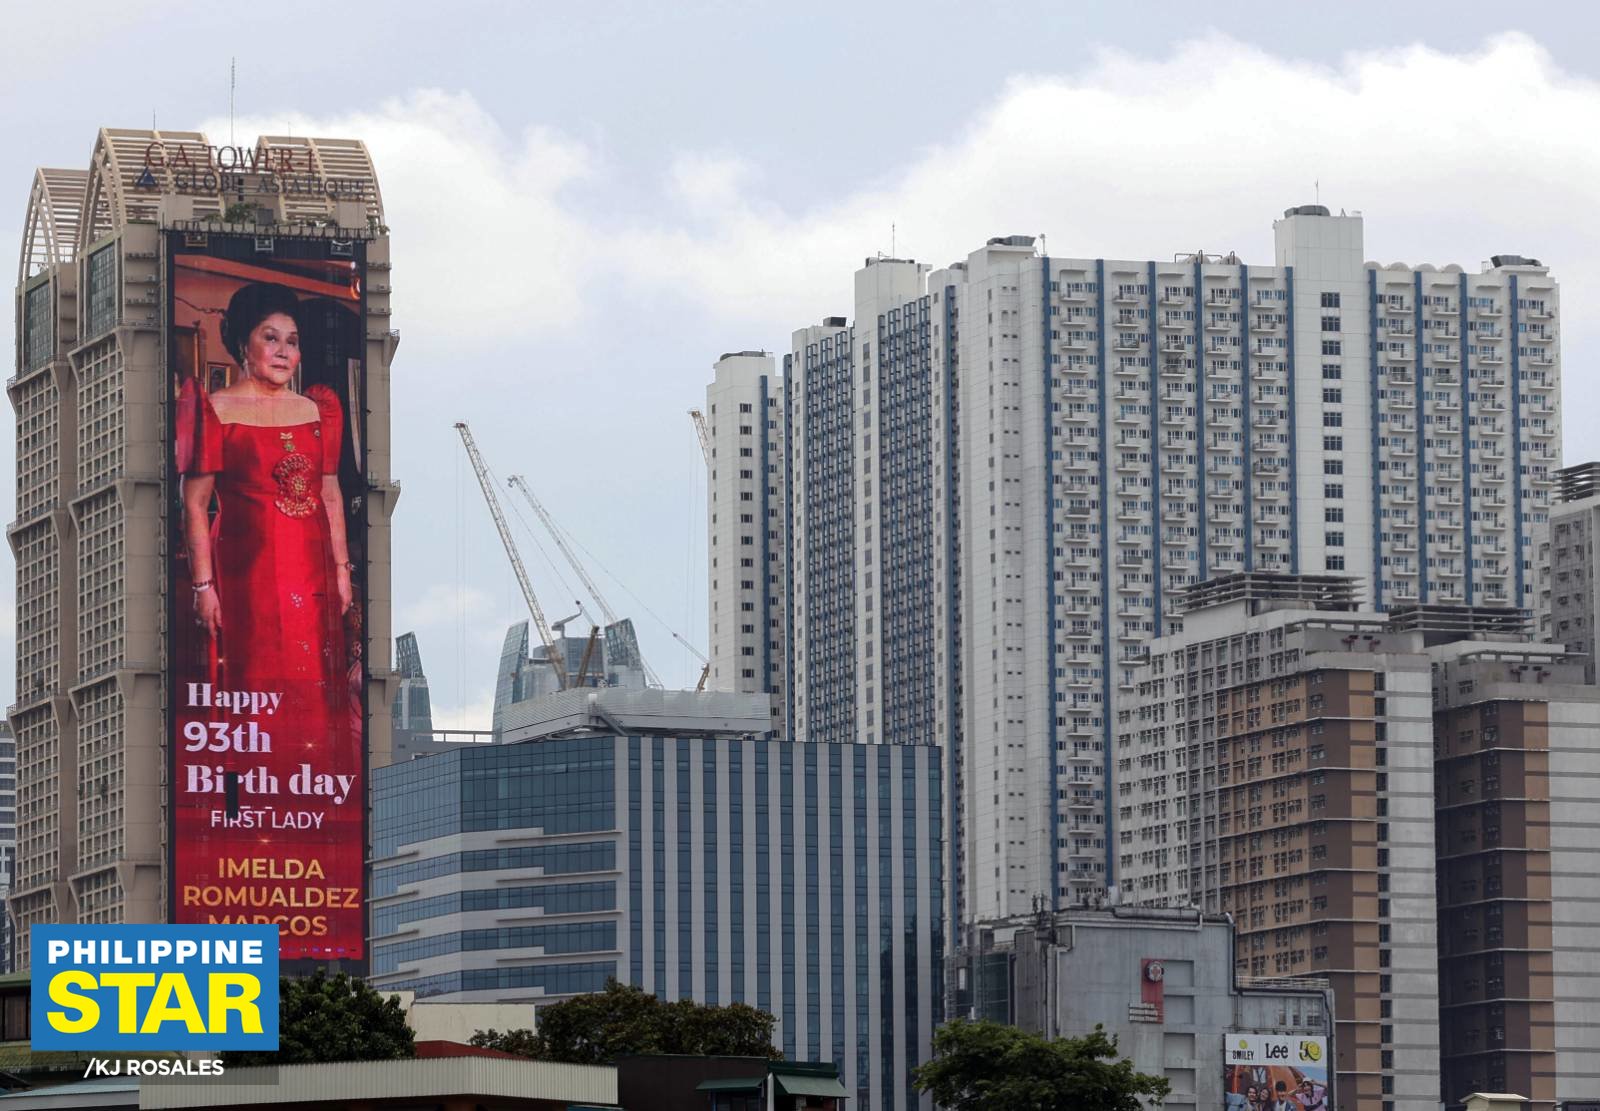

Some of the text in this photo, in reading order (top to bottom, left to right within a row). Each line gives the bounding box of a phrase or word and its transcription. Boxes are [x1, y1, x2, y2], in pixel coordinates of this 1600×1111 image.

[176, 173, 241, 192] GLOBE
[186, 682, 284, 715] Happy
[183, 721, 272, 753] 93th
[288, 763, 357, 805] day
[271, 811, 325, 829] LADY
[218, 858, 326, 880] IMELDA
[183, 885, 360, 908] ROMUALDEZ
[1232, 1050, 1254, 1060] SMILEY
[1265, 1042, 1289, 1059] Lee
